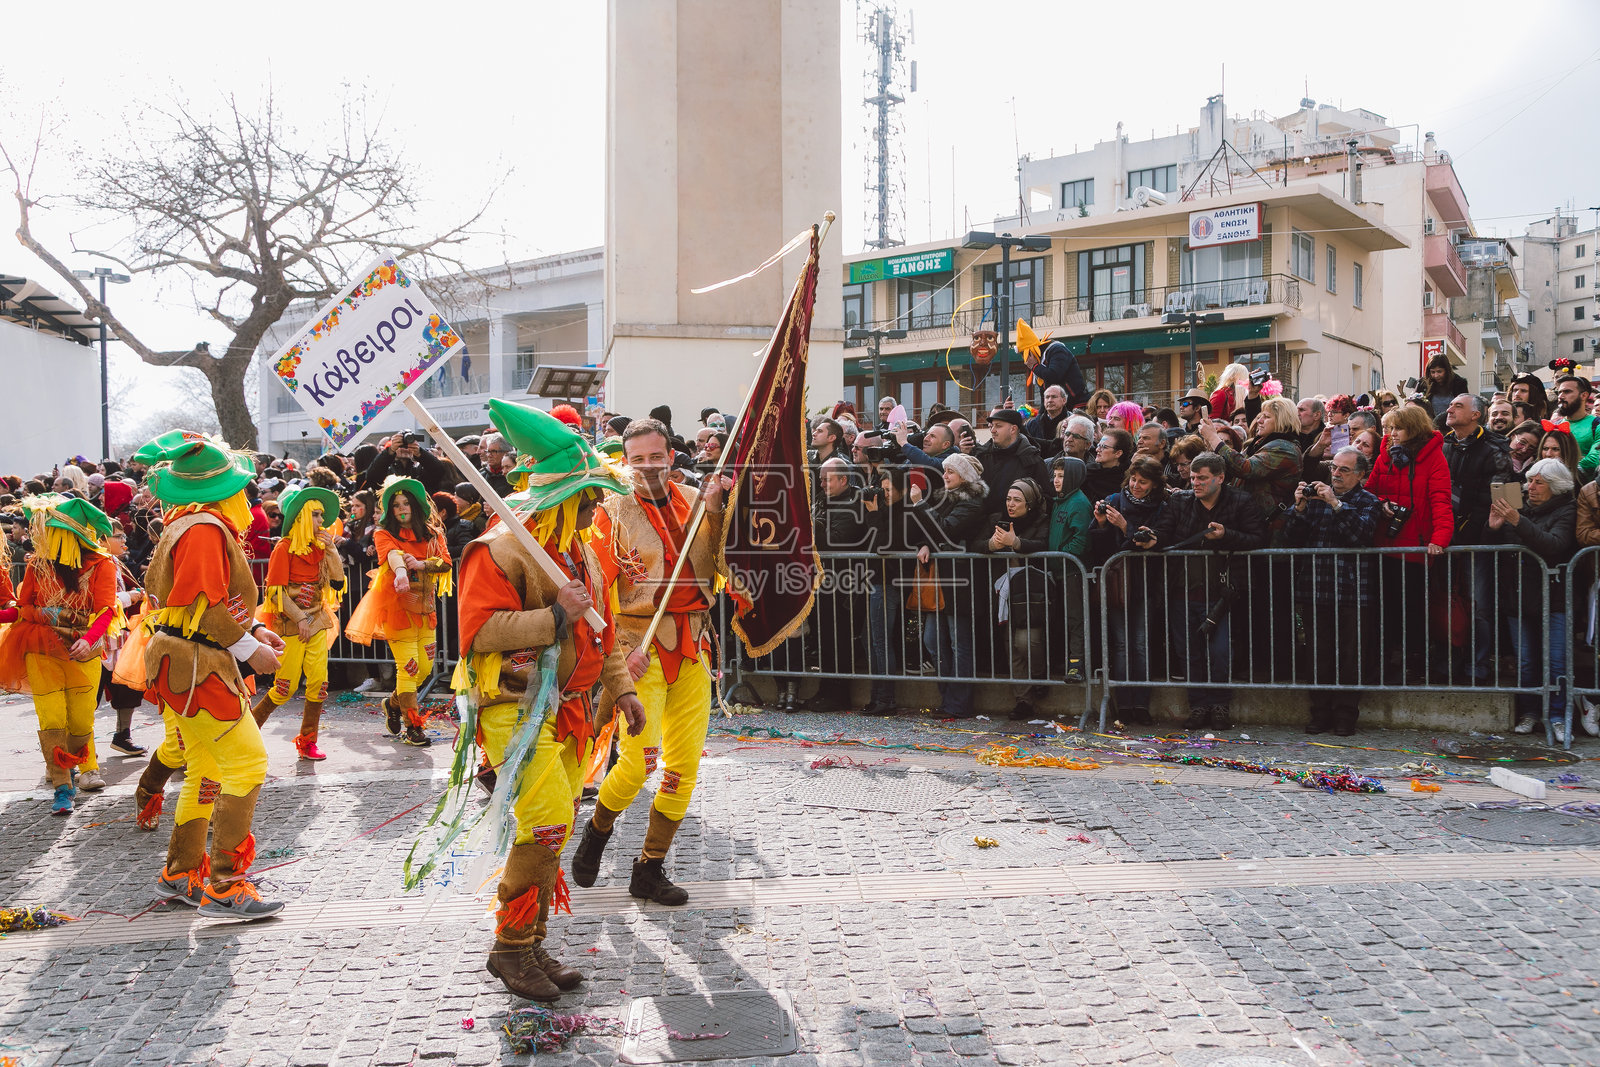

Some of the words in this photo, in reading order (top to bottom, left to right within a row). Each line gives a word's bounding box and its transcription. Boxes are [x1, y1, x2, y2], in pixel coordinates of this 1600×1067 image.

[1214, 207, 1255, 218] ΑΘΛΗΤΙΚΗ
[1220, 219, 1248, 228] ΕΝΩΣΗ
[1217, 230, 1251, 240] ΞΑΝΘΗΣ
[893, 259, 941, 275] ΞΑΝΘΗΣ
